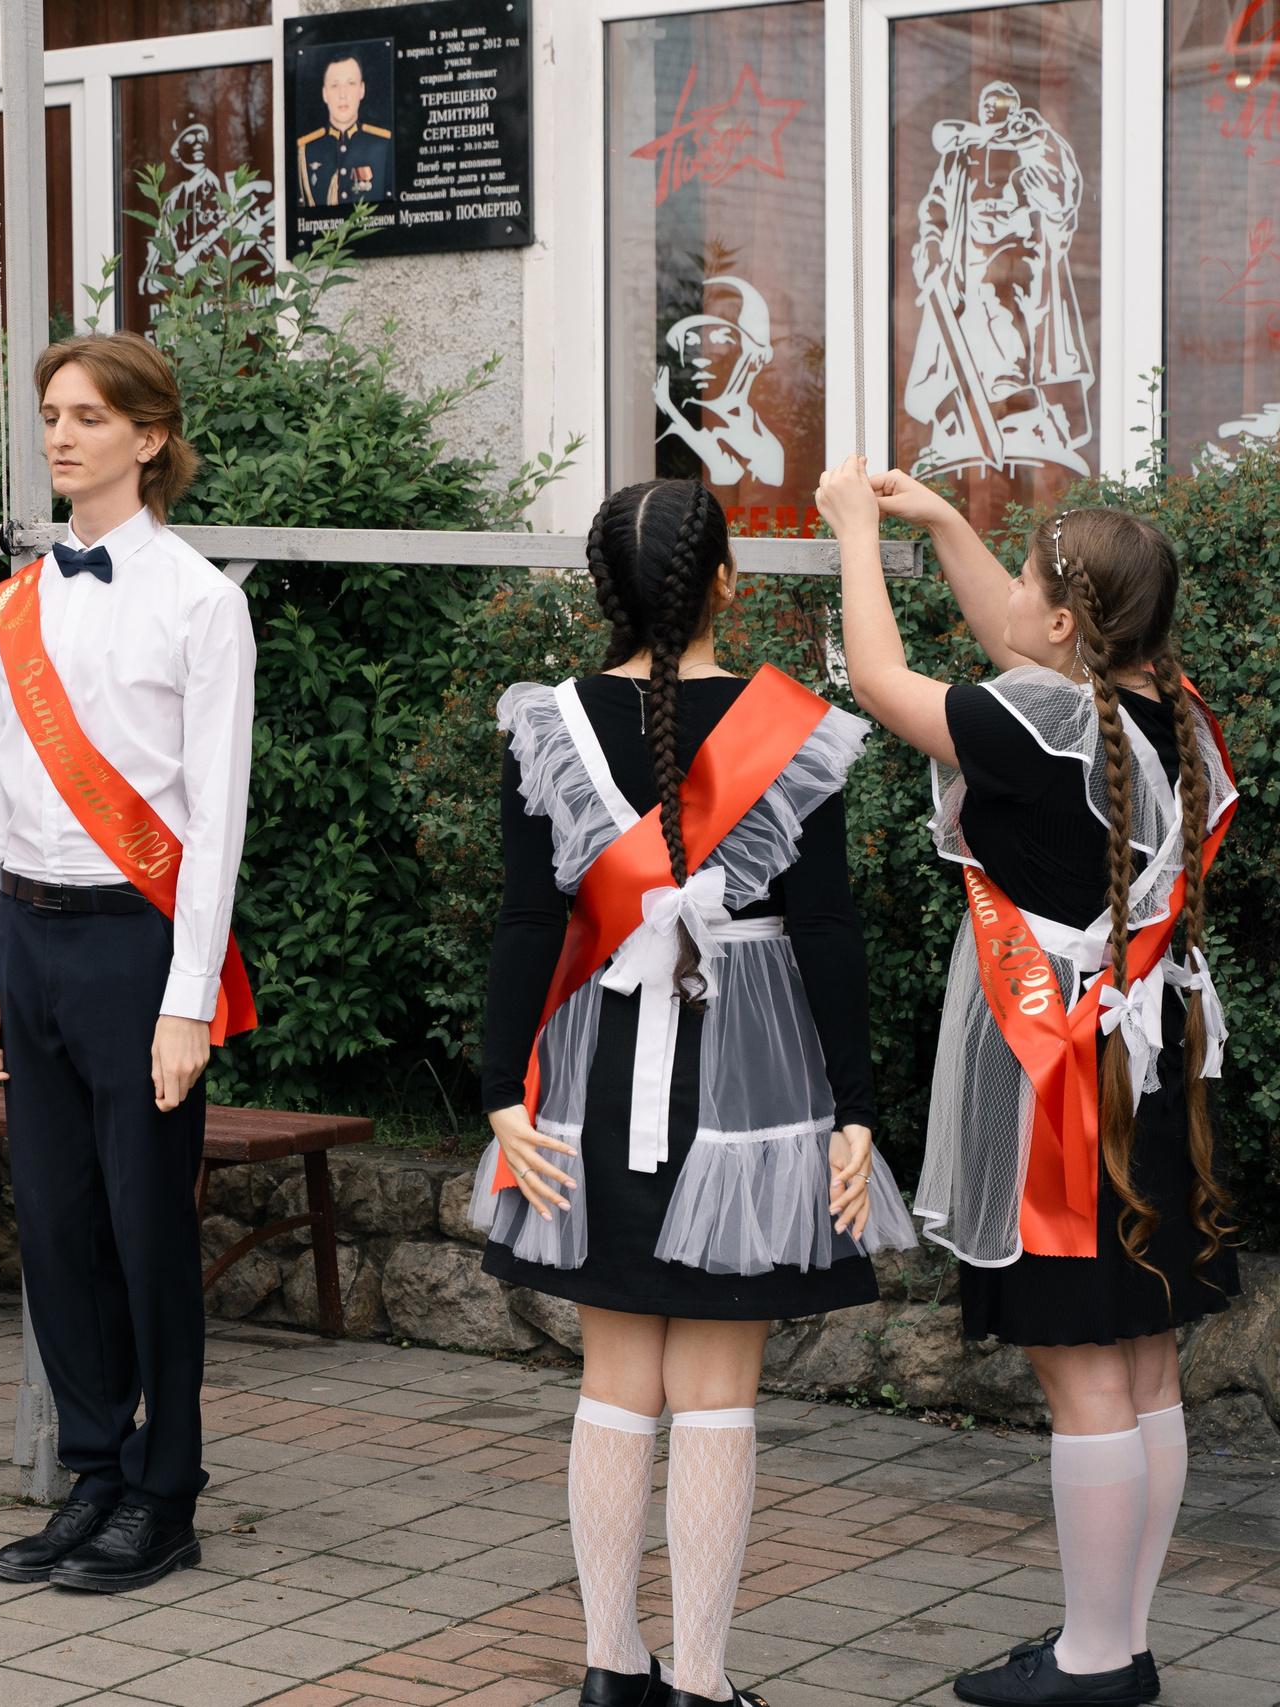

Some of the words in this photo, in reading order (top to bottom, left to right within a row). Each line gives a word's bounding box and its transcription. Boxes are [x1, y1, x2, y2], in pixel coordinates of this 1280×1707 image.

[429, 30, 437, 41] В
[440, 28, 458, 39] этой
[461, 26, 487, 38] школе
[397, 49, 404, 59] в
[406, 46, 435, 59] период
[446, 41, 466, 54] 2002
[468, 42, 480, 51] по
[483, 37, 502, 50] 2012
[505, 37, 520, 47] год
[444, 57, 472, 70] учился
[419, 71, 454, 86] старший
[457, 68, 498, 81] лейтенант
[420, 87, 497, 107] ТЕРЕЩЕНКО
[427, 103, 490, 125] ДМИТРИЙ
[422, 122, 494, 142] СЕРГЕЕВИЧ
[416, 160, 440, 173] Погиб
[442, 161, 457, 172] при
[459, 158, 502, 169] исполнении
[413, 175, 455, 188] служебного
[457, 173, 478, 184] долга
[489, 171, 506, 180] ходе
[400, 188, 447, 202] Специальной
[449, 185, 481, 198] Военной
[484, 184, 520, 196] Операции
[456, 200, 522, 221] ПОСМЕРТНО
[11, 620, 123, 827] Выпускник
[115, 820, 182, 880] 2026
[988, 925, 1061, 1016] 2026
